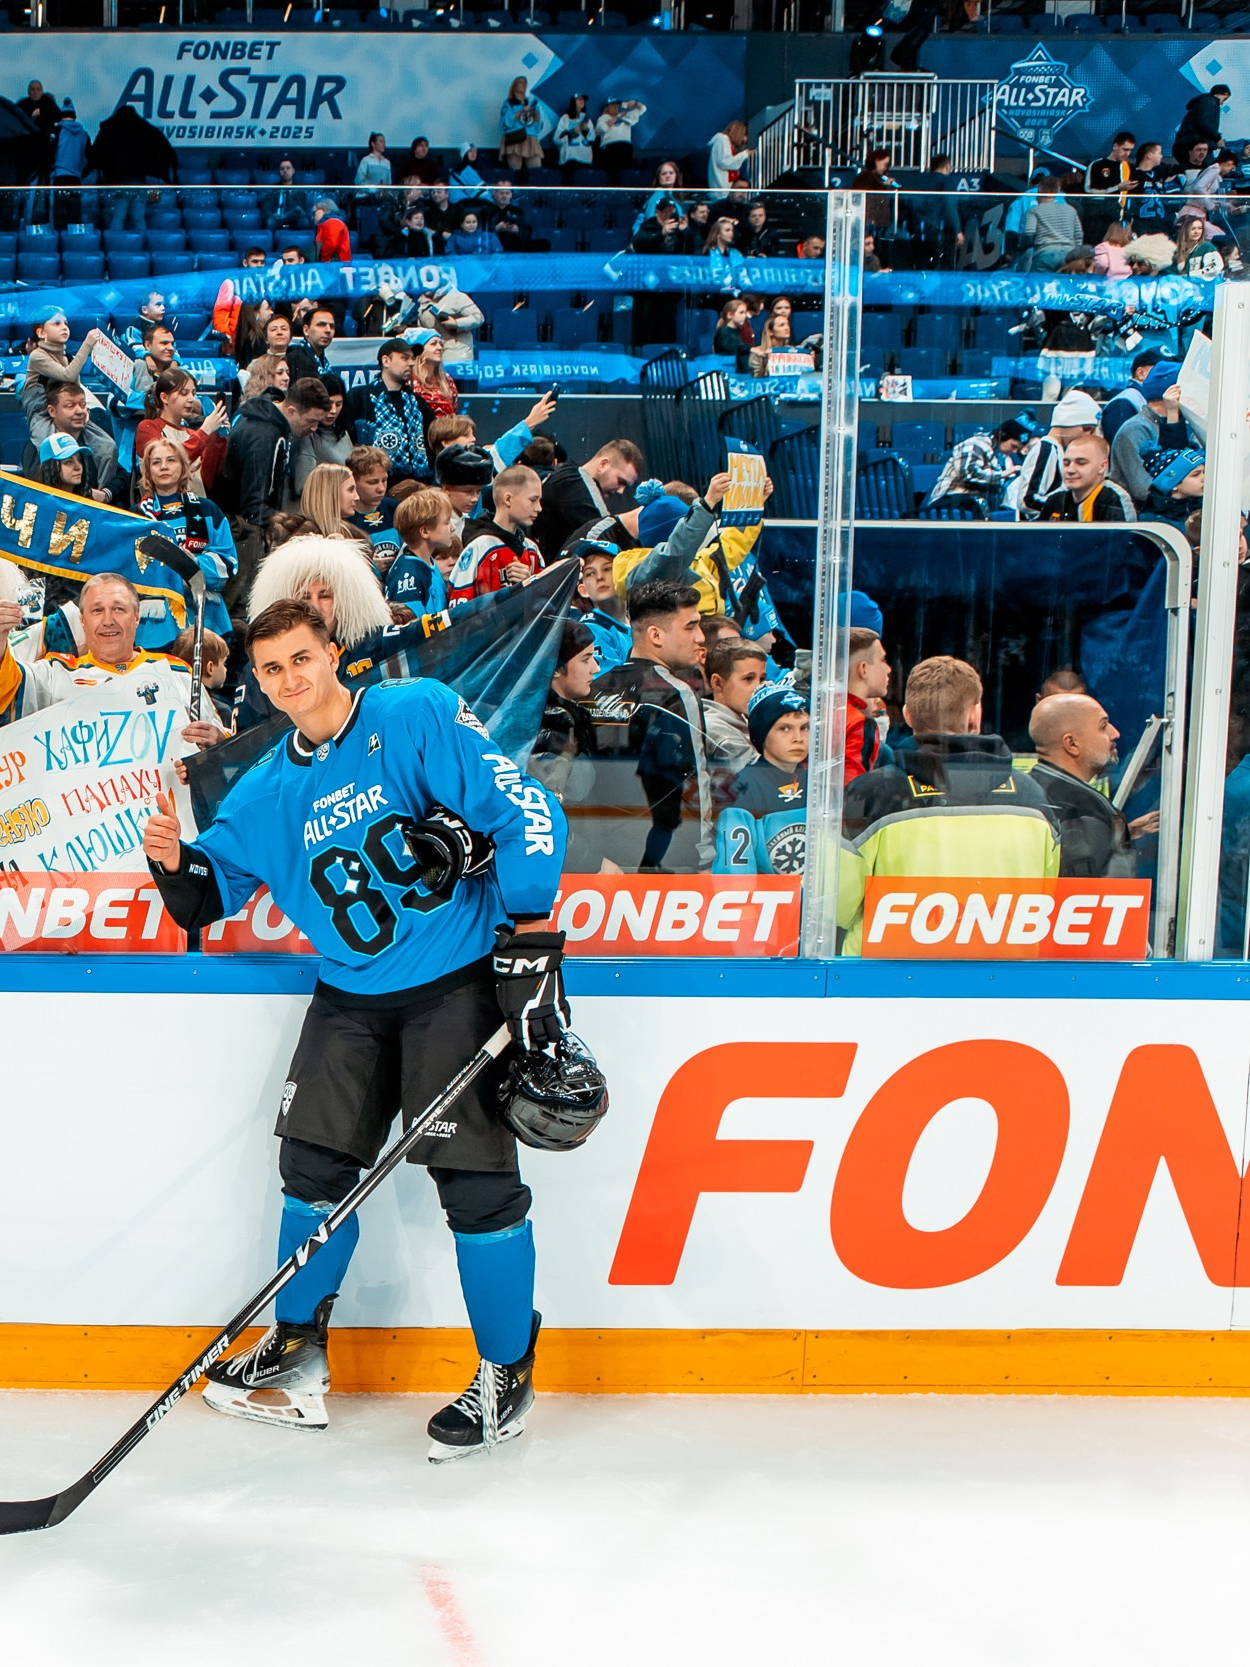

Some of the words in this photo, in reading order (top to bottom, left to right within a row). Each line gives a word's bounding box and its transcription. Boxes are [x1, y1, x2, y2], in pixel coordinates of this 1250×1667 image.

[177, 40, 282, 61] FONBET
[1019, 75, 1057, 84] FONBET
[159, 125, 259, 140] VOSIBIRSK
[268, 125, 315, 140] 2025
[956, 178, 981, 193] A3
[312, 782, 356, 814] FONBET
[308, 811, 456, 958] 89
[866, 891, 1145, 946] FONBET
